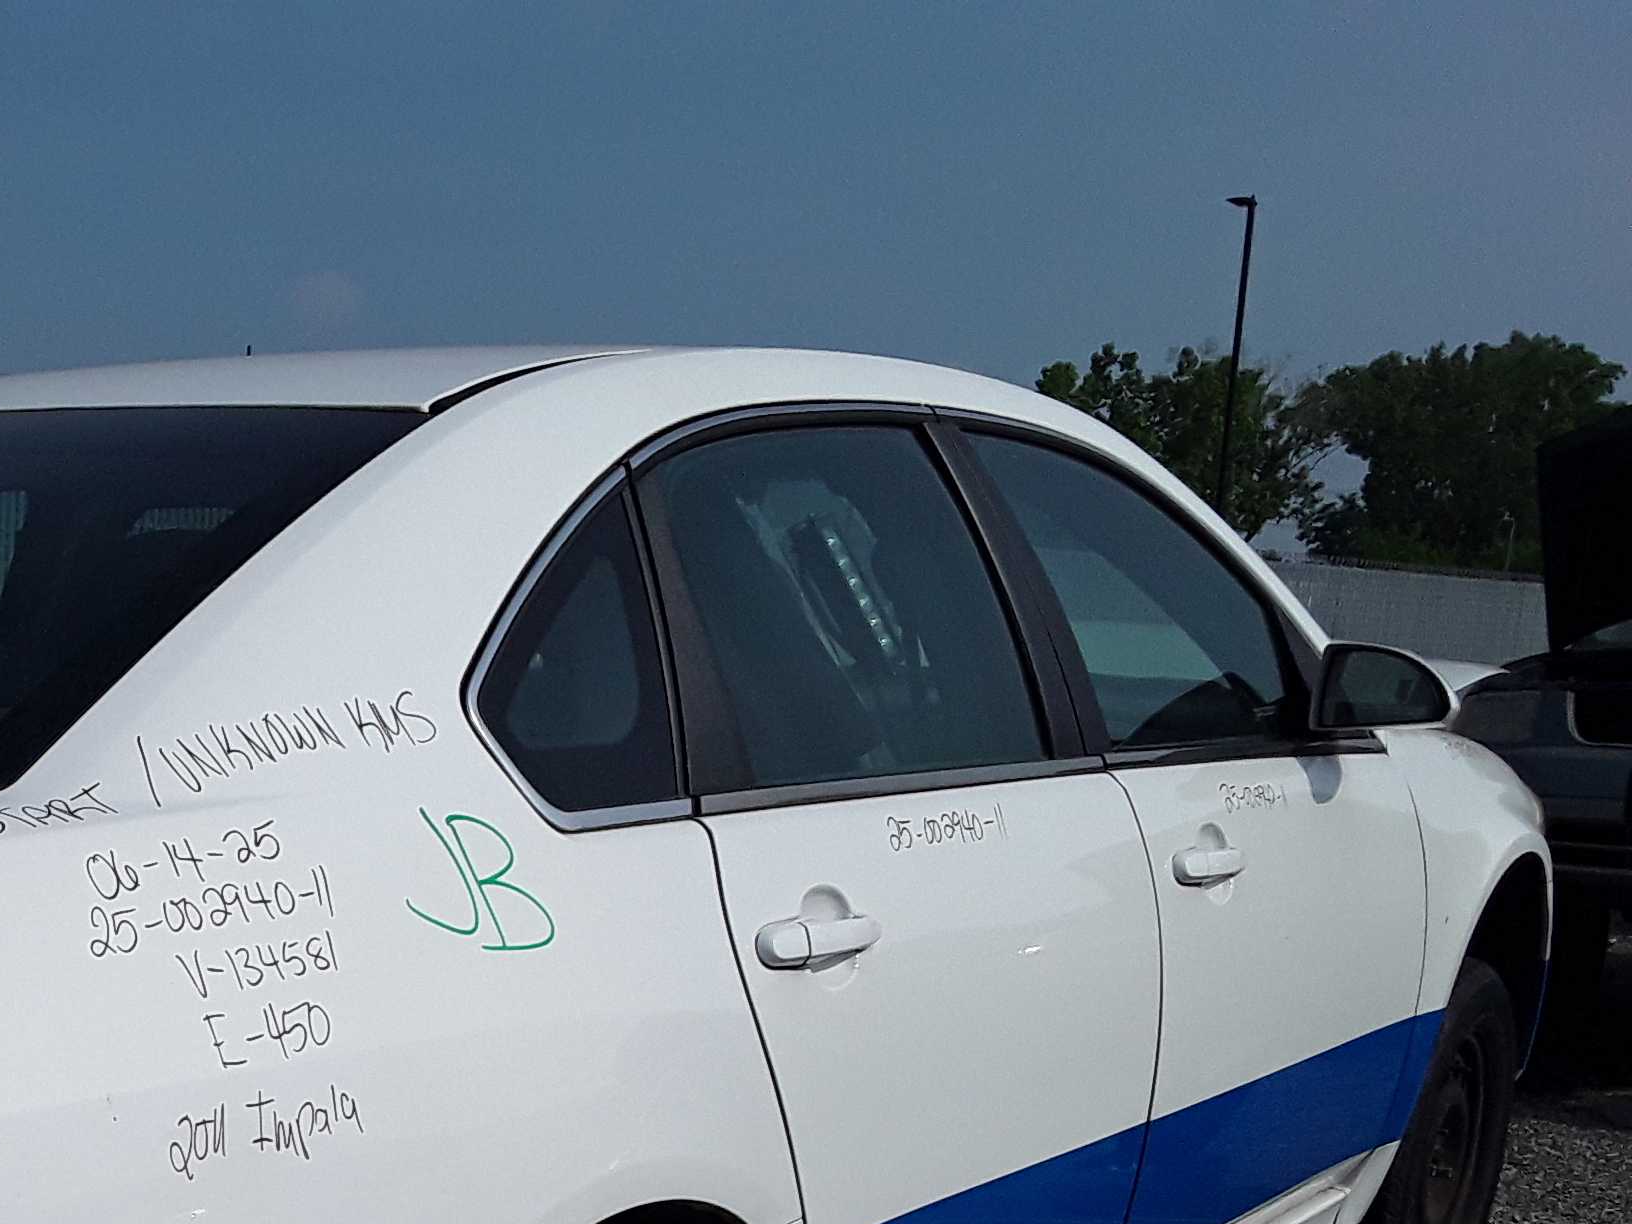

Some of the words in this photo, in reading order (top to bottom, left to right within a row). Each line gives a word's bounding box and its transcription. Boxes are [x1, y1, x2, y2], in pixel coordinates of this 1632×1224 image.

[343, 690, 437, 753] KMS
[86, 819, 280, 900] 06-14-25
[886, 802, 1008, 852] 25-002940-11
[89, 864, 334, 958] 25-002940-11
[405, 805, 556, 951] JB
[174, 929, 339, 999] V-134581
[169, 1101, 227, 1181] 2011
[244, 1083, 364, 1161] Impala
